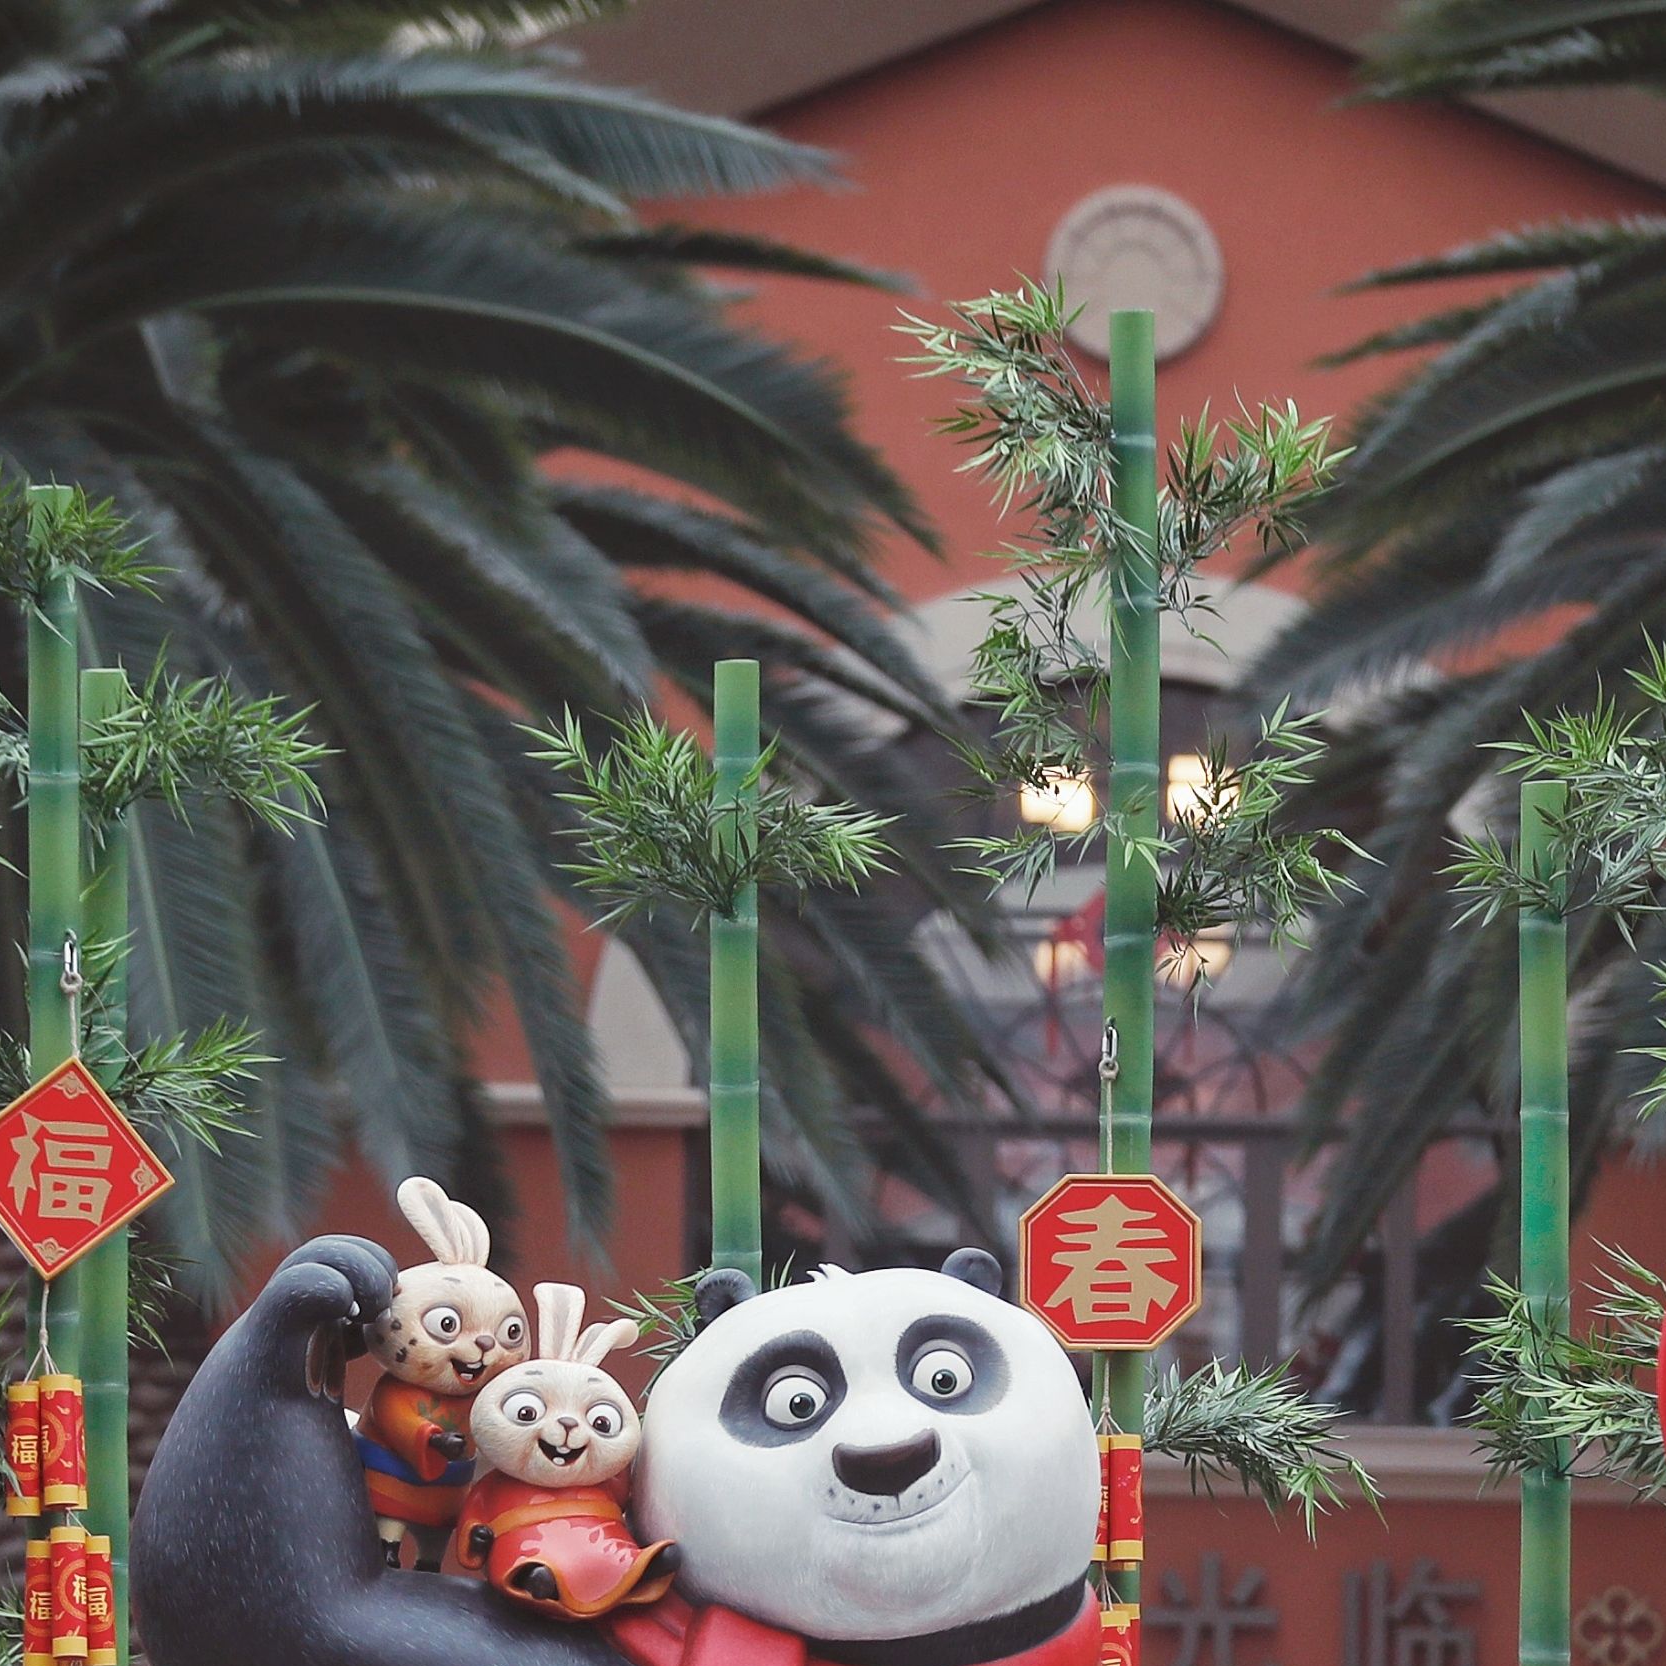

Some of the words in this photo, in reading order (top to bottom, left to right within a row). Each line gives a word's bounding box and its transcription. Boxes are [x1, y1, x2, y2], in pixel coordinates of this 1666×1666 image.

[7, 1110, 114, 1226] 福
[1044, 1194, 1179, 1325] 春
[11, 1434, 39, 1465] 福
